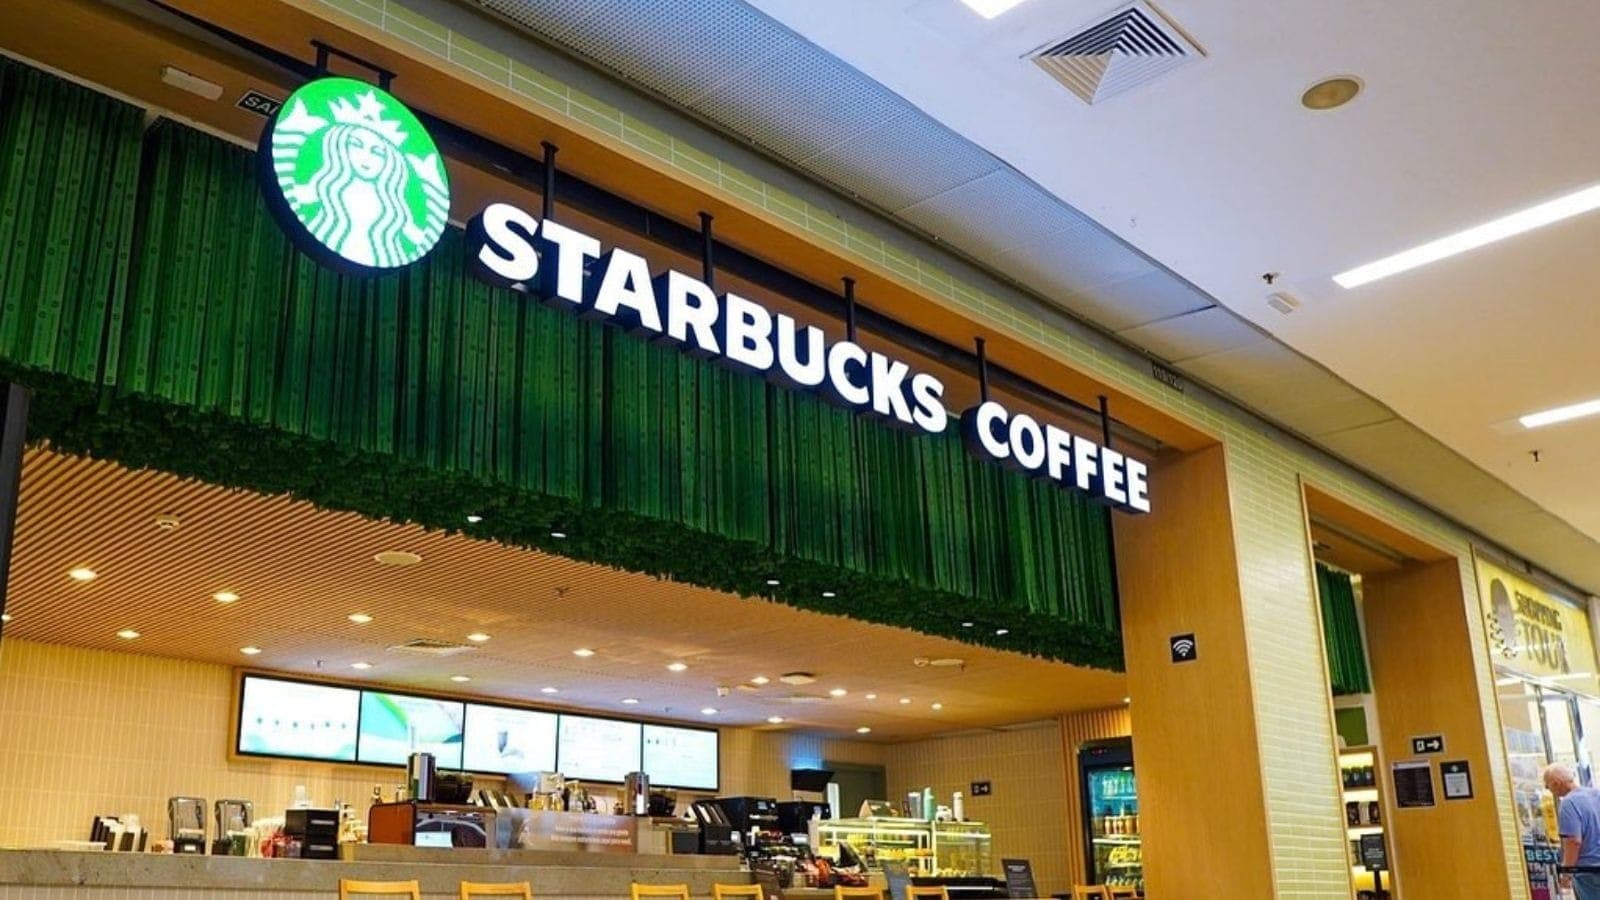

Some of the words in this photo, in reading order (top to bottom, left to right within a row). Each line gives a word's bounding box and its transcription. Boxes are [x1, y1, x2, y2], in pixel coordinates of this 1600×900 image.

[478, 203, 947, 432] STARBUCKS
[976, 401, 1151, 513] COFFEE
[1526, 849, 1559, 861] BEST
